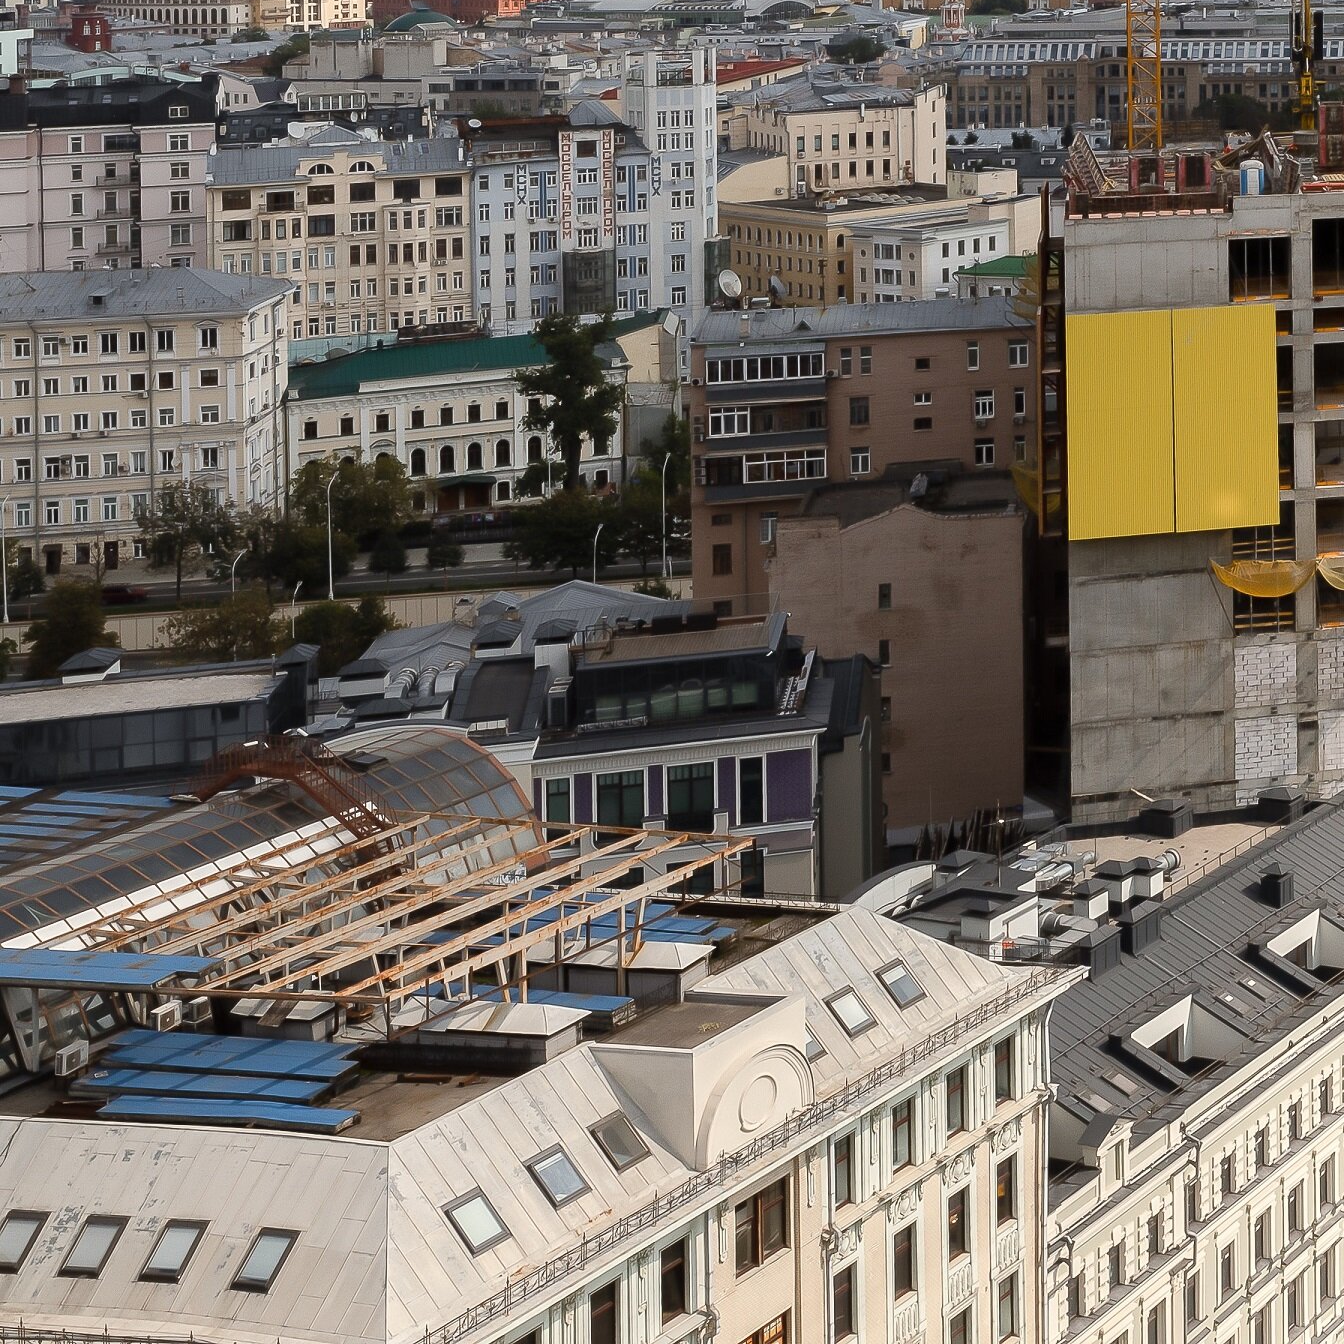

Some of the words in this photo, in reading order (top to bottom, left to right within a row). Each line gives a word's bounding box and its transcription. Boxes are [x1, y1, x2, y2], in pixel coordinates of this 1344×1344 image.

[516, 164, 527, 206] МСНХ
[561, 133, 572, 240] МОССЕЛЬПРОМ
[602, 130, 613, 237] МОССЕЛПРОМ
[651, 156, 661, 197] МСНХ
